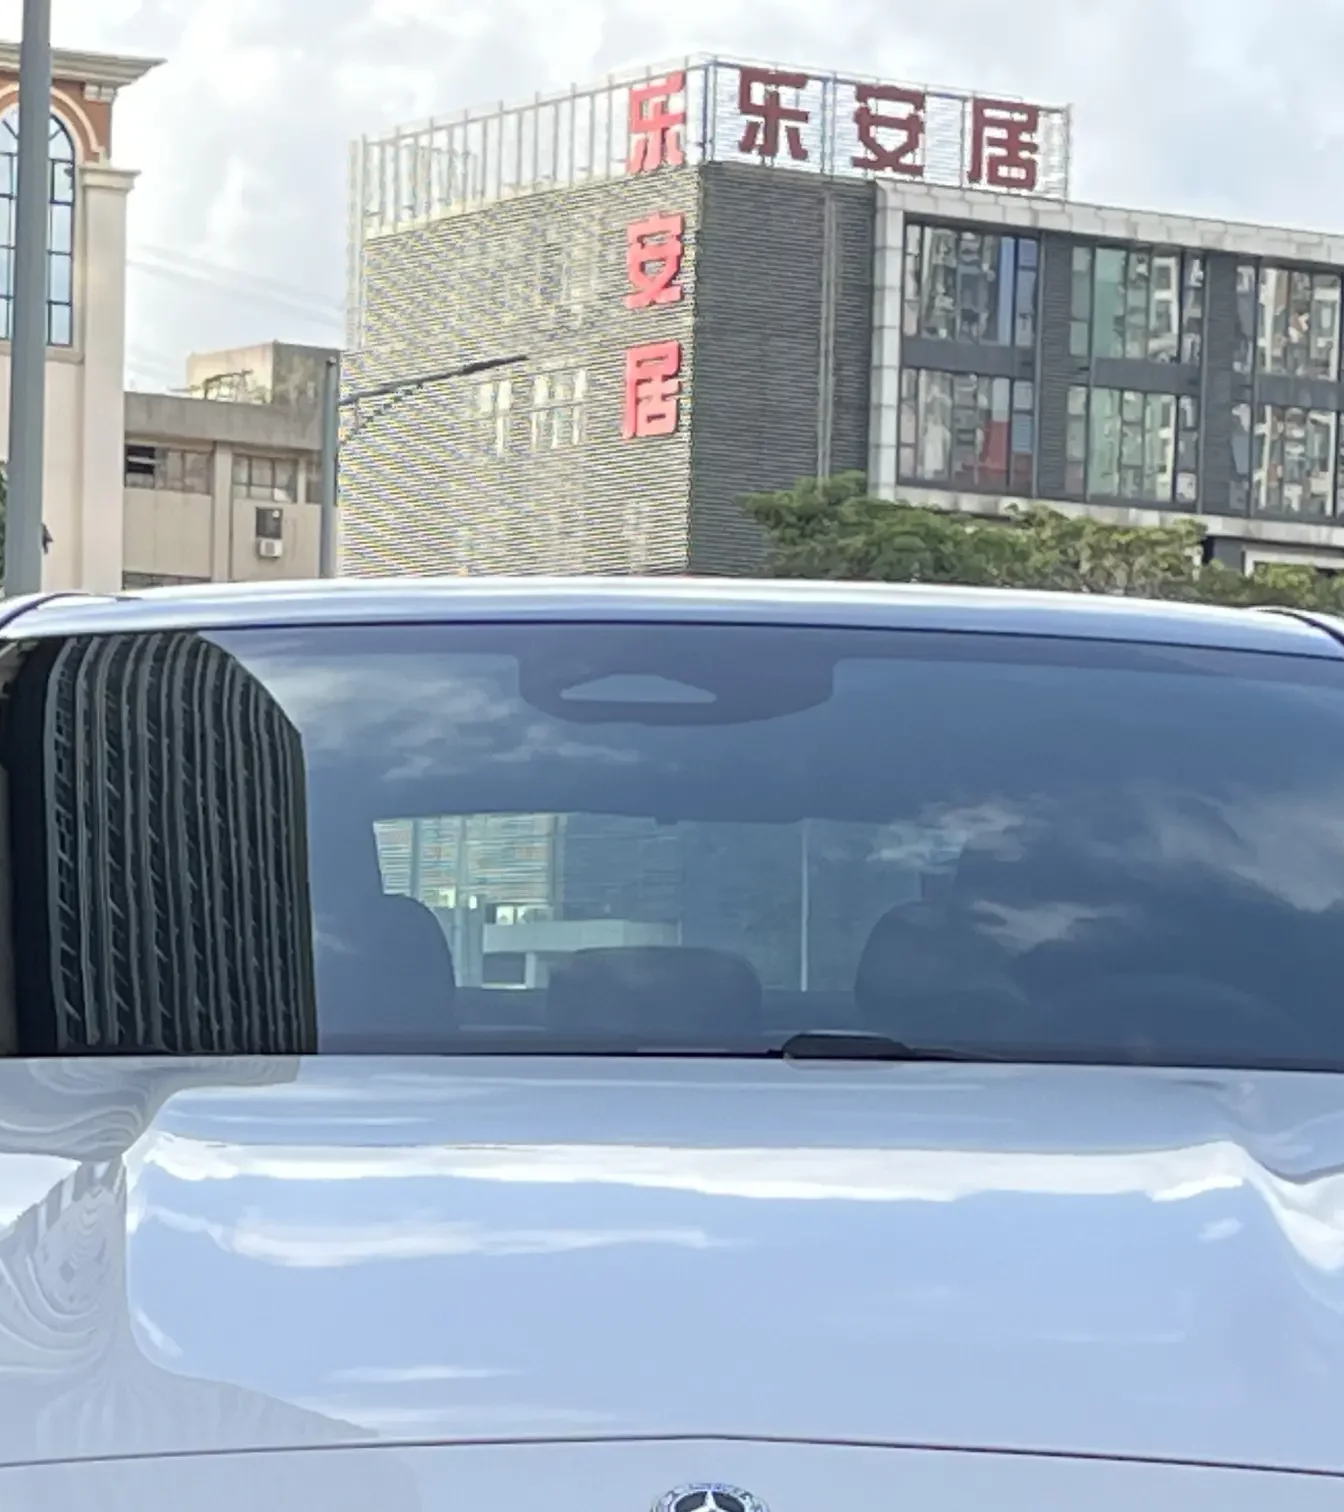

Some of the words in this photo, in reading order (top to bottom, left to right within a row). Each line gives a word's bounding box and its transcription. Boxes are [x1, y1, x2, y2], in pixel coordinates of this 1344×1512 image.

[738, 67, 1040, 190] 乐安居
[621, 72, 687, 440] 乐安居
